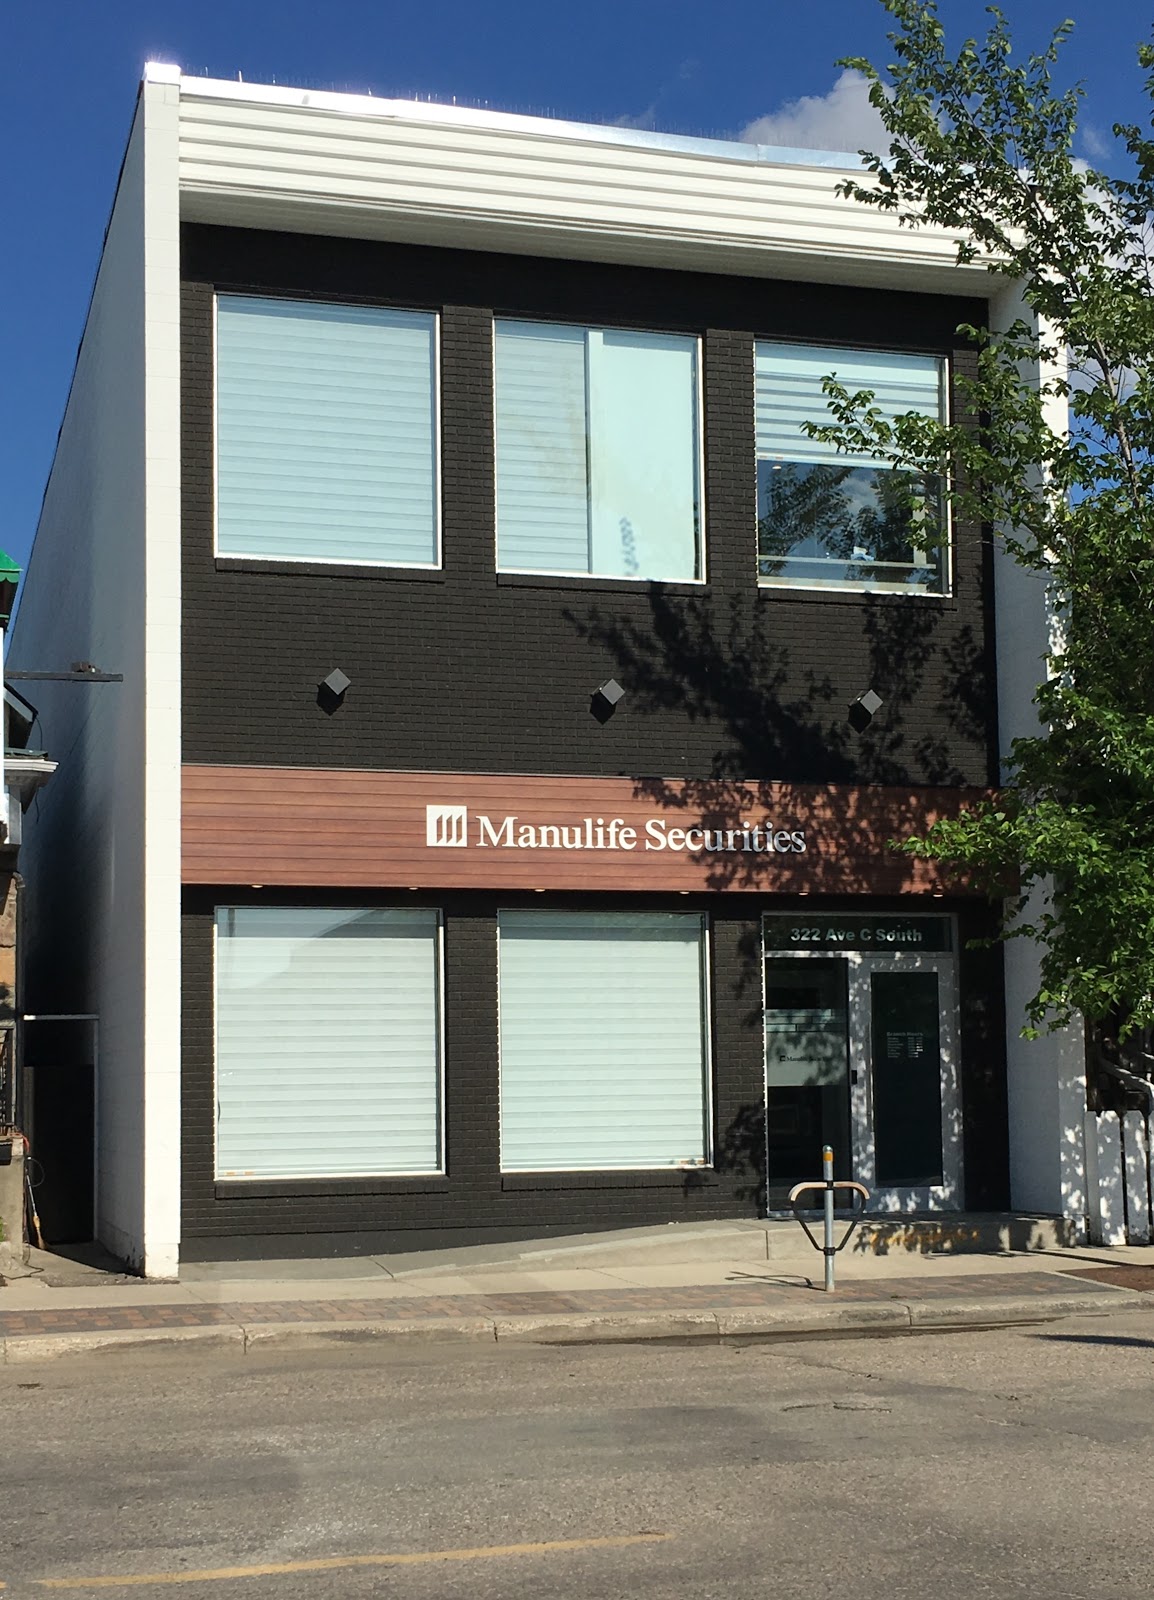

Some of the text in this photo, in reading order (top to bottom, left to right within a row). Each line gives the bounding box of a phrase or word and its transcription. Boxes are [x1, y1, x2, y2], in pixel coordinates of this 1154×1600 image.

[475, 815, 807, 854] Manulife Securities
[790, 928, 923, 942] 322 Ave C South
